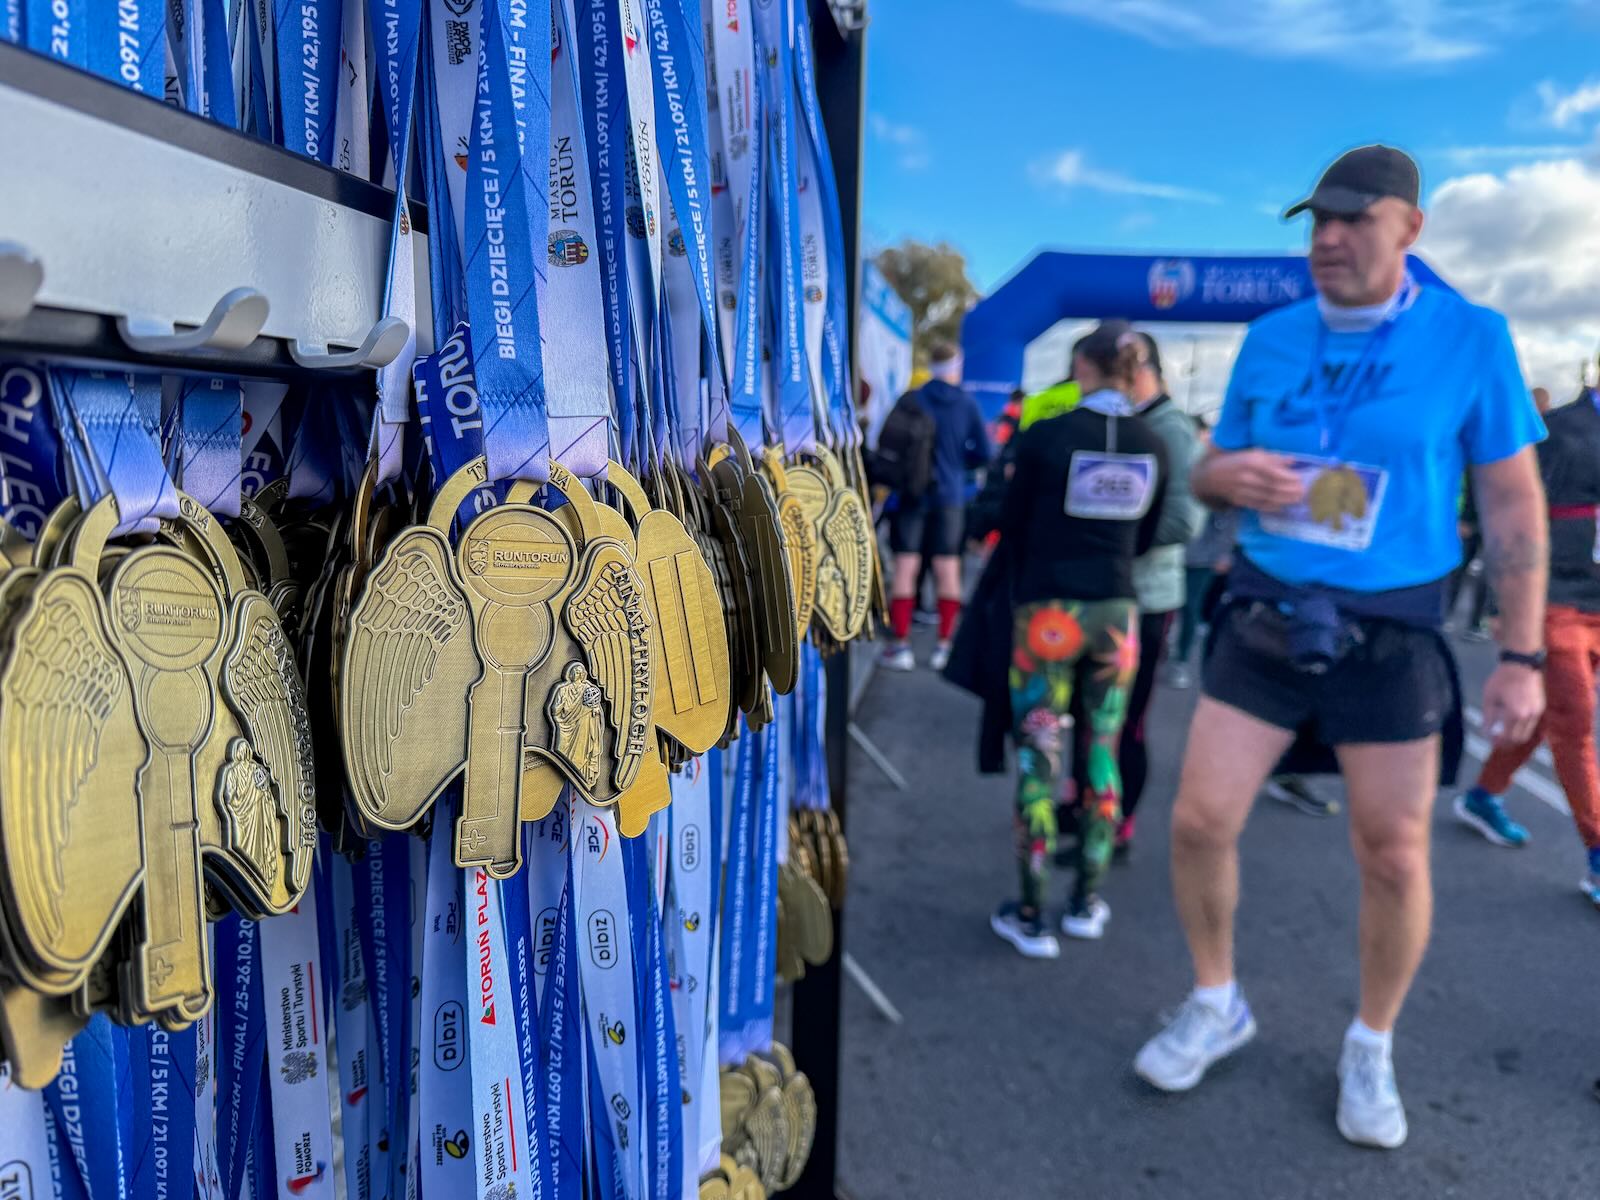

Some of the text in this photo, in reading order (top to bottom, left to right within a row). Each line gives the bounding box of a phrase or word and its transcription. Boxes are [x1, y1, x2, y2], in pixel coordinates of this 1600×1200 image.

[301, 6, 322, 71] 42,195
[451, 20, 464, 65] ARTUSA
[592, 13, 608, 69] 42,195
[479, 111, 495, 146] KM
[596, 112, 609, 170] 21,097
[668, 92, 689, 146] 21,097
[481, 150, 496, 163] 5
[682, 157, 698, 186] KM
[551, 157, 561, 219] MIASTO
[554, 136, 579, 224] TORUŃ
[601, 181, 611, 214] KM
[687, 187, 700, 200] 5
[483, 173, 510, 298] DZIECIĘCE
[603, 215, 612, 227] 5
[604, 238, 620, 338] DZIECIĘCE
[493, 300, 516, 360] BIEGI
[611, 341, 624, 386] BIEGI
[612, 567, 647, 641] FINAŁ
[630, 641, 650, 756] TRYLOGII
[551, 809, 564, 844] PGE
[586, 826, 600, 854] PGE
[370, 860, 386, 937] DZIECIĘCE
[446, 902, 457, 936] PGE
[593, 917, 612, 962] ziaja
[290, 963, 304, 1008] Turystyki
[476, 929, 496, 1001] TORUŃ
[517, 935, 533, 1056] 25-26.10.2025
[553, 997, 565, 1006] 5
[281, 987, 293, 1051] Ministerstwo
[295, 1015, 307, 1048] Sportu
[438, 1010, 457, 1062] ziaja
[552, 1011, 565, 1035] KM
[233, 1022, 247, 1072] FINAŁ
[151, 1069, 168, 1079] 5
[151, 1082, 168, 1111] KM
[230, 1083, 243, 1110] KM
[523, 1068, 537, 1118] FINAŁ
[549, 1050, 563, 1100] 21,097
[490, 1082, 505, 1128] Turystyki
[295, 1142, 304, 1175] KUJAWY
[303, 1131, 312, 1172] POMORZE
[483, 1113, 494, 1187] Ministerstwo
[497, 1142, 508, 1179] Sportu
[528, 1129, 542, 1159] KM
